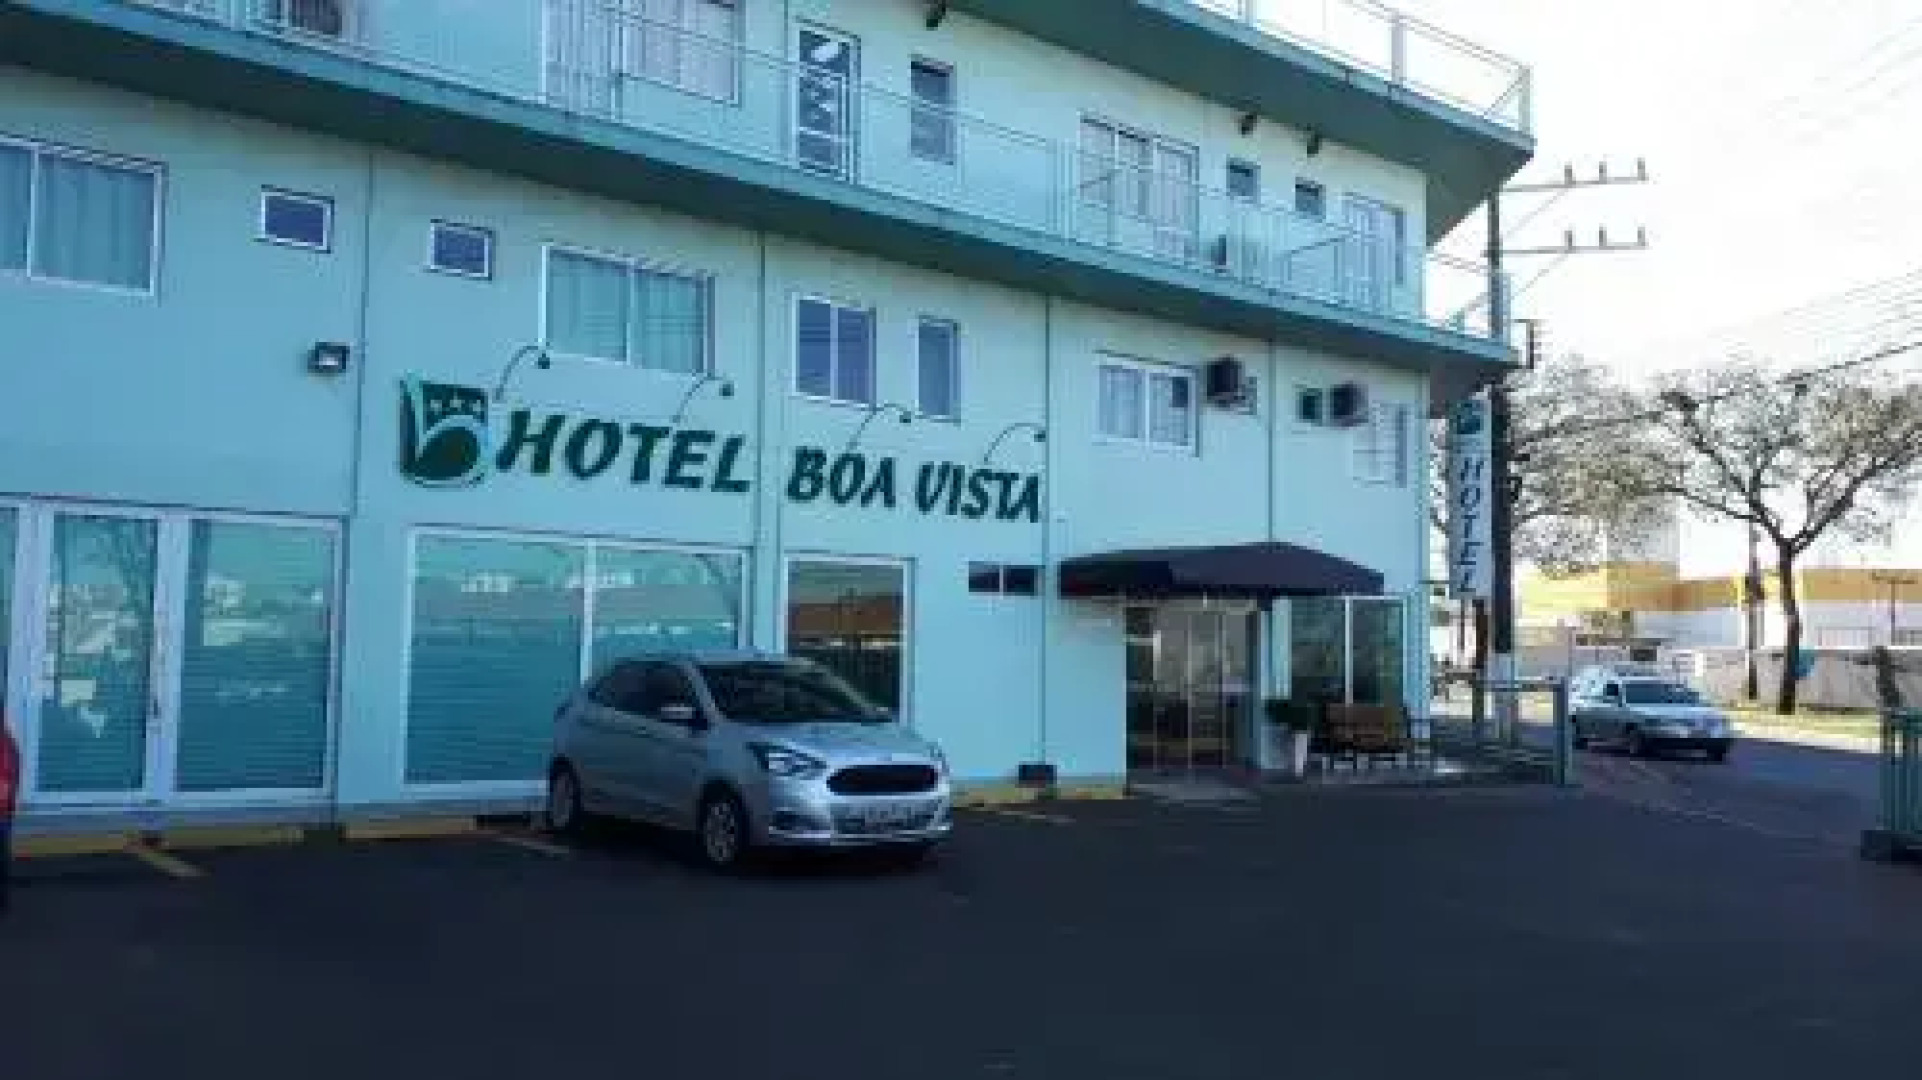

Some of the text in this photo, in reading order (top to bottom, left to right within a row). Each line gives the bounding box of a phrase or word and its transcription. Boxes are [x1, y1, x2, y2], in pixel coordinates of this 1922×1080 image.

[495, 409, 1039, 523] HOTEL BOA VISTA
[1457, 458, 1485, 592] HOTEL
